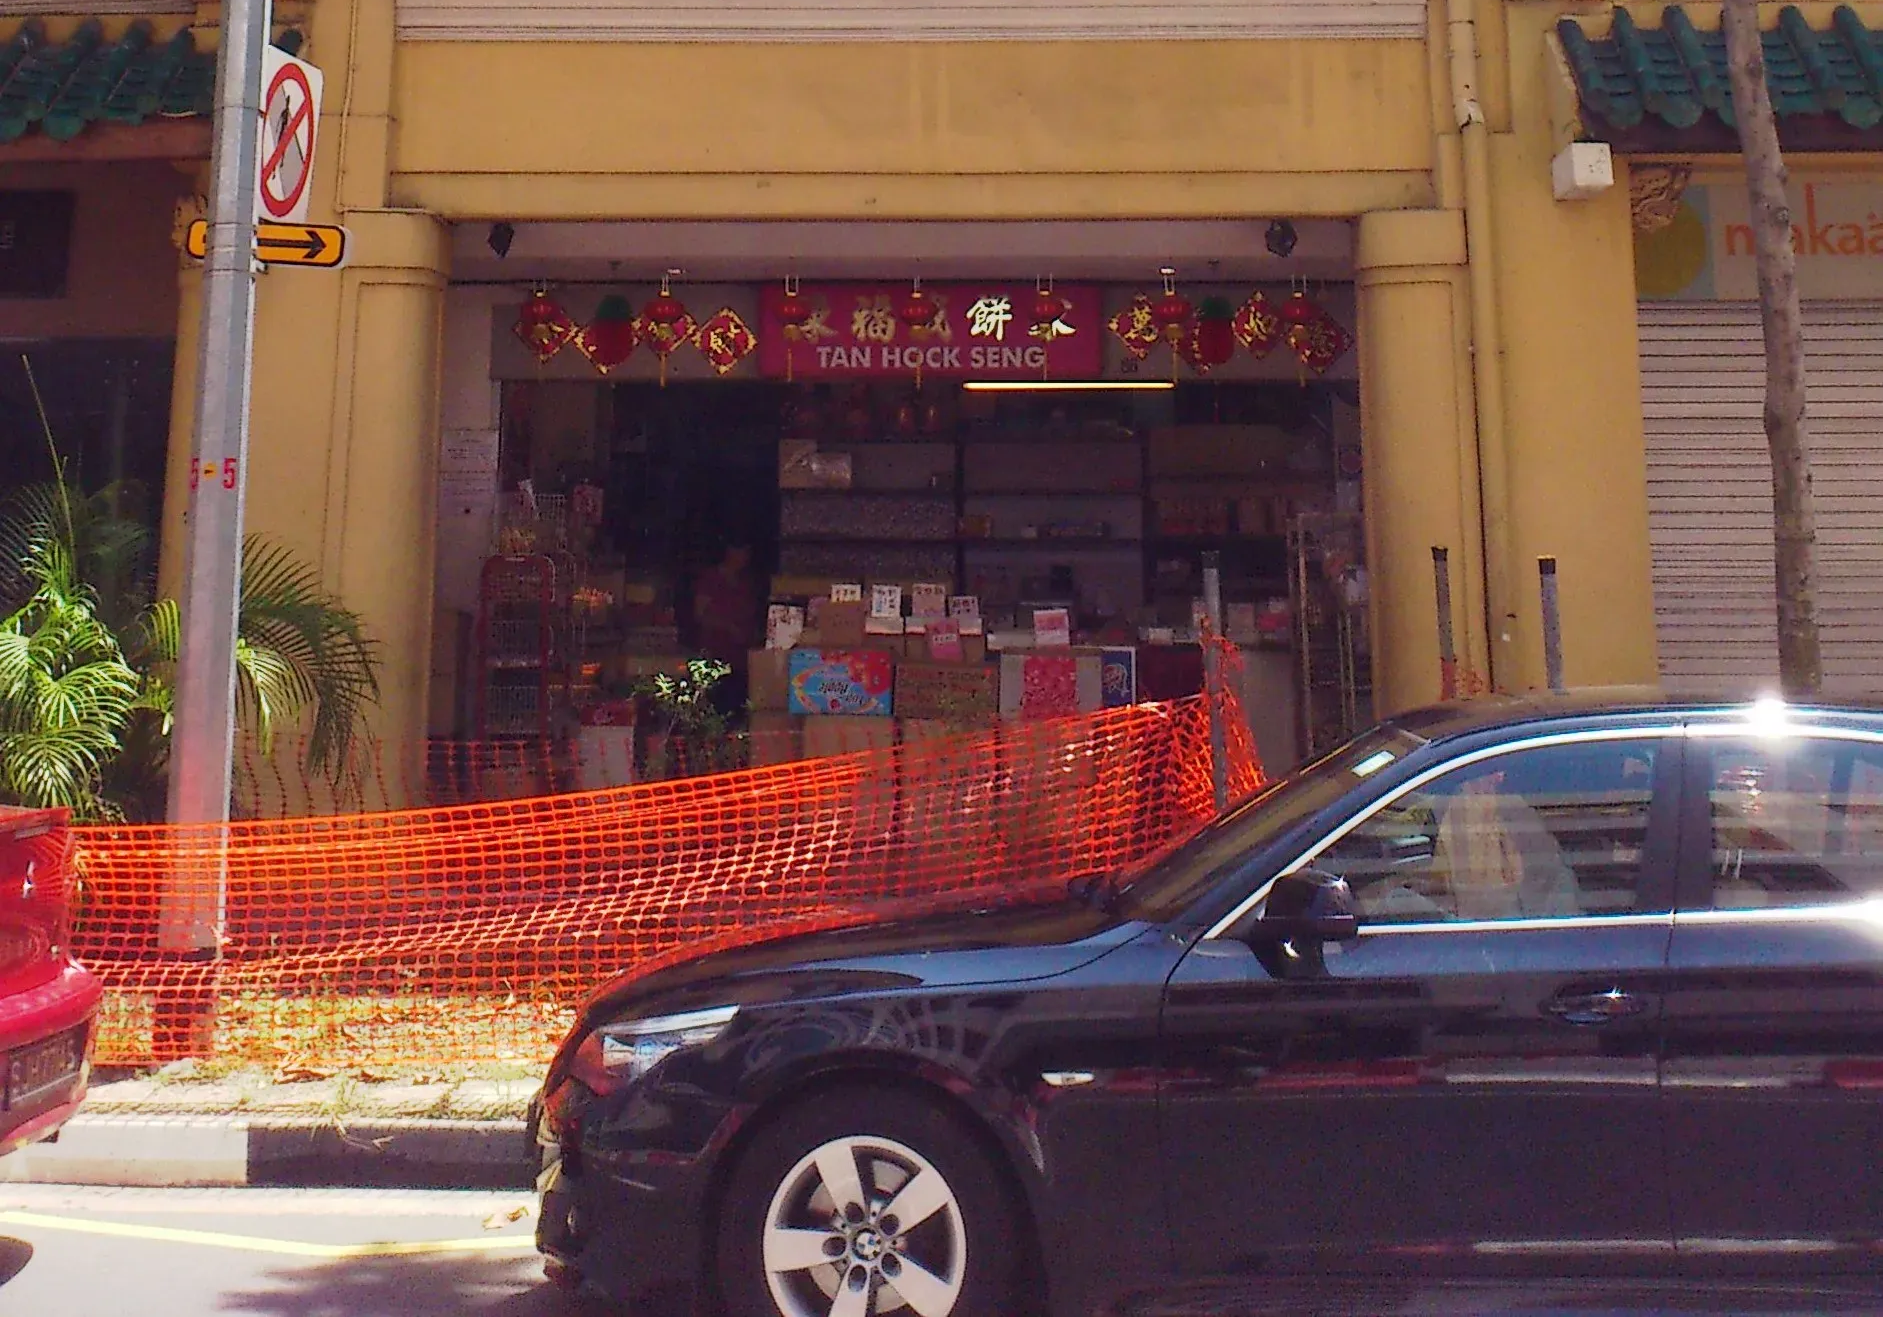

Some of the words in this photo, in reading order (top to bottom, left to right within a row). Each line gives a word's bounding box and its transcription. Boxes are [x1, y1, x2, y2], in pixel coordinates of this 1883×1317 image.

[816, 346, 872, 369] TAN
[881, 345, 962, 370] HOCK
[970, 345, 1046, 370] SENG
[223, 457, 237, 490] 5
